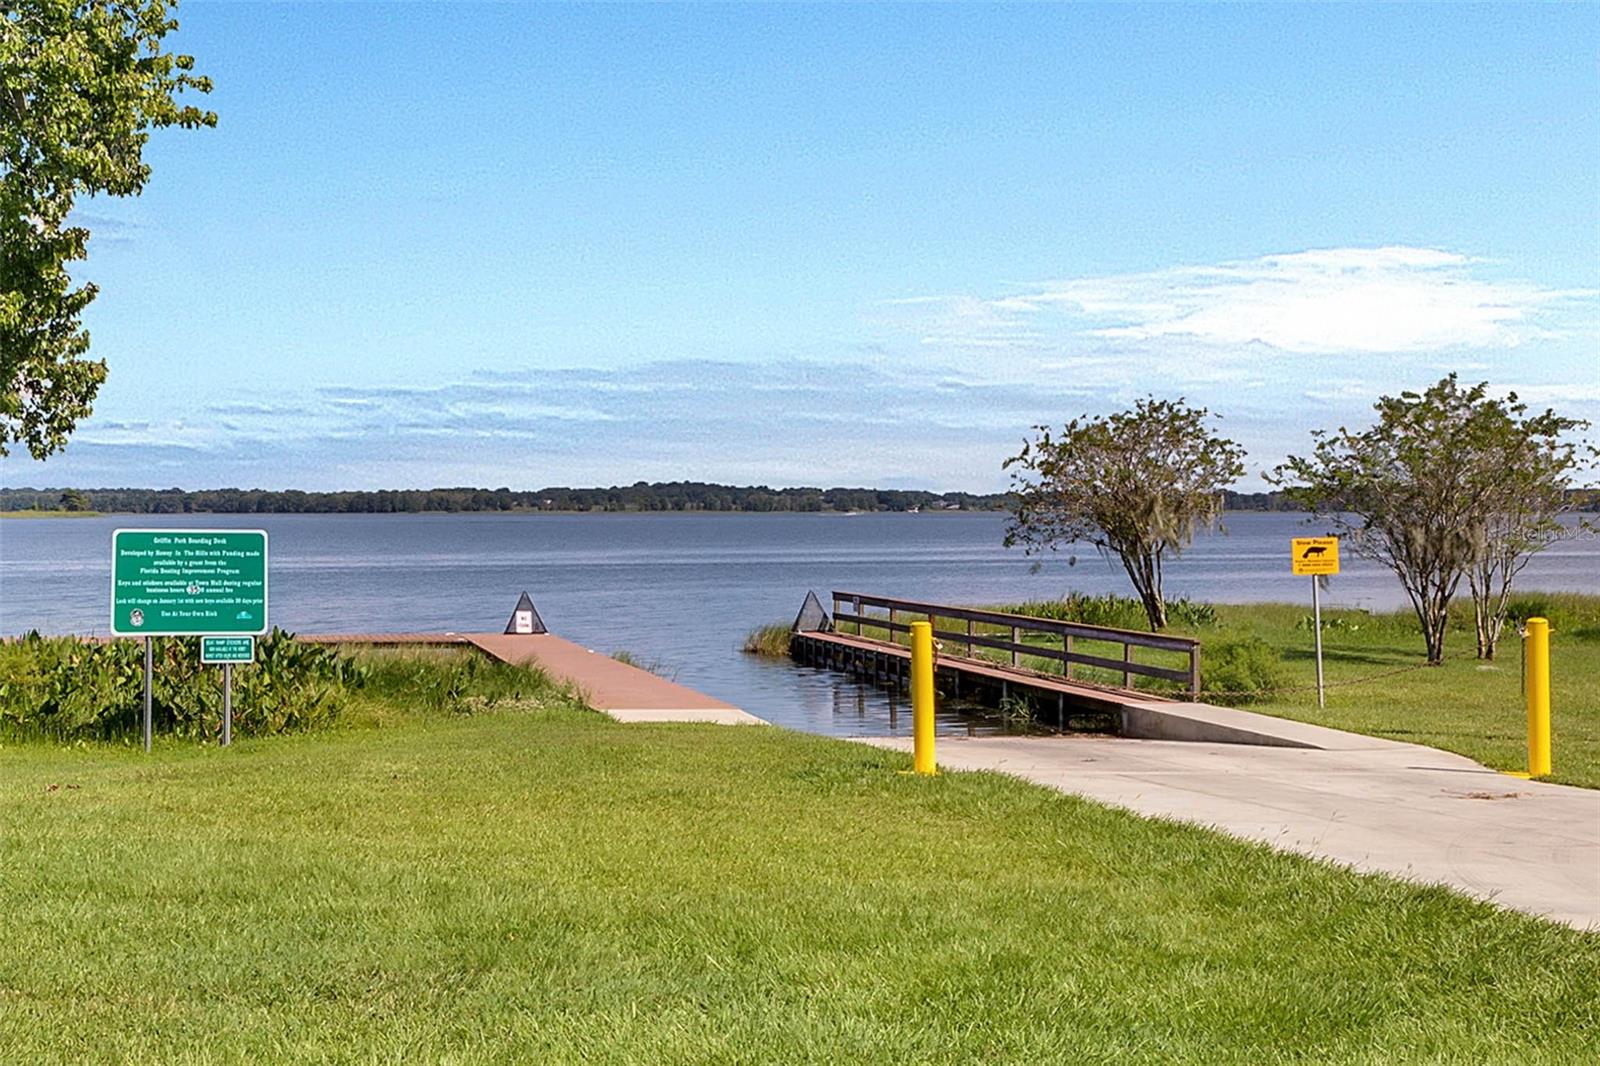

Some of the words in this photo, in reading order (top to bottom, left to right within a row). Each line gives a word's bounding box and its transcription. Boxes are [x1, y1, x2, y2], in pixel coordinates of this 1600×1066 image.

[188, 537, 212, 546] Boarding
[216, 568, 240, 576] Program
[223, 580, 241, 588] during
